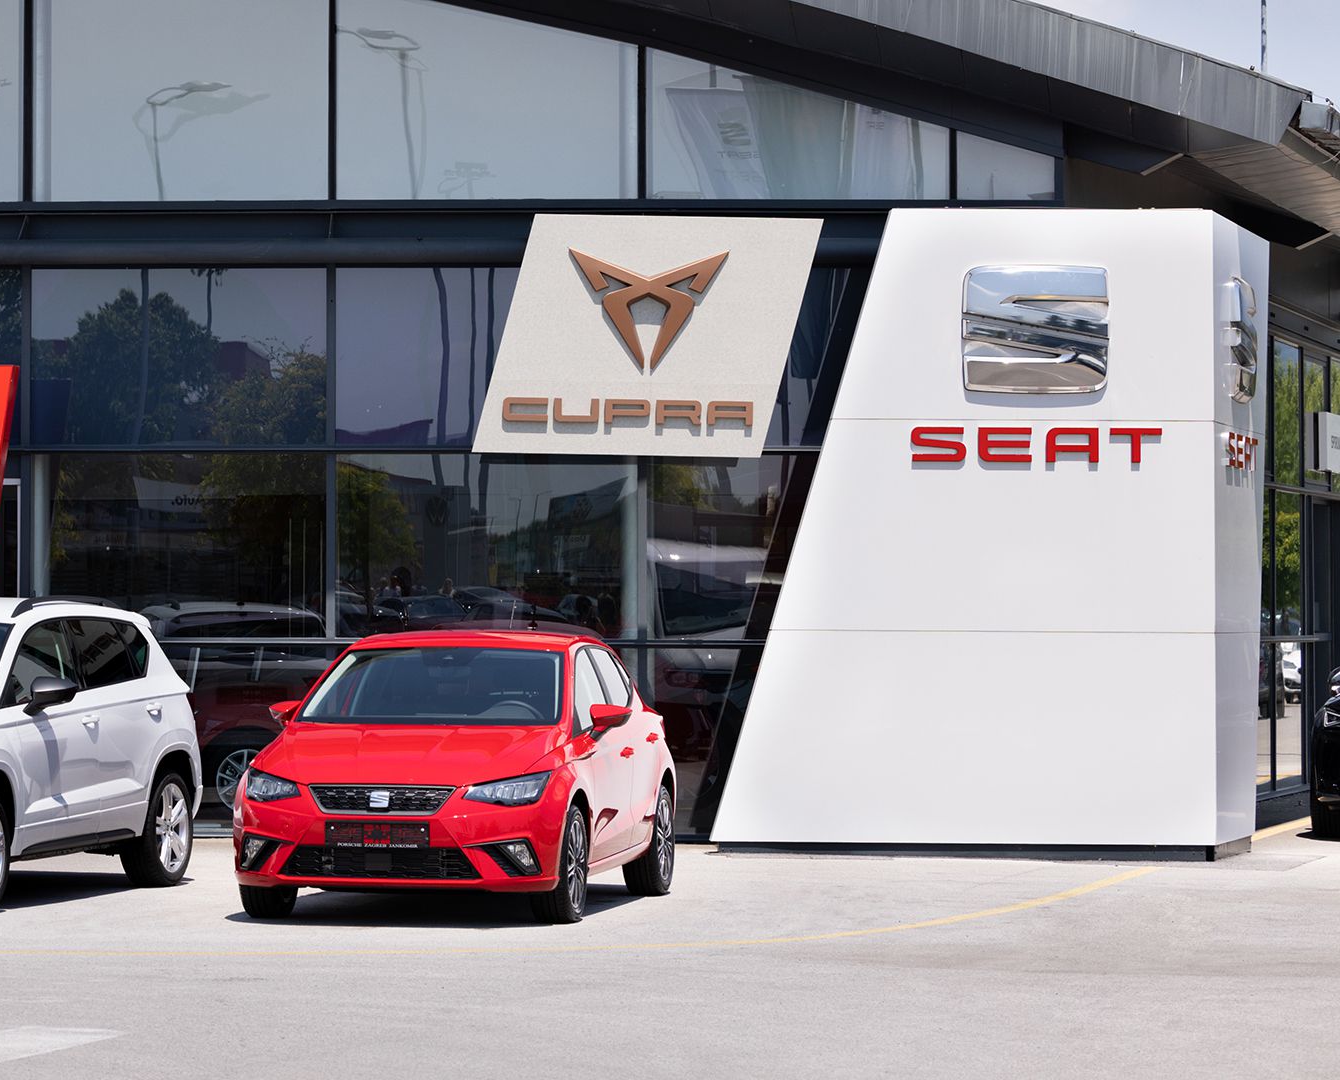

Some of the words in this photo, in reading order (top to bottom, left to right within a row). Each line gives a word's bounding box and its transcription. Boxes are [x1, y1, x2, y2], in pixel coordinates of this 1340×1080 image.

[502, 397, 754, 426] CUPRA
[911, 427, 1162, 463] SEAT
[1226, 432, 1258, 471] SEAT
